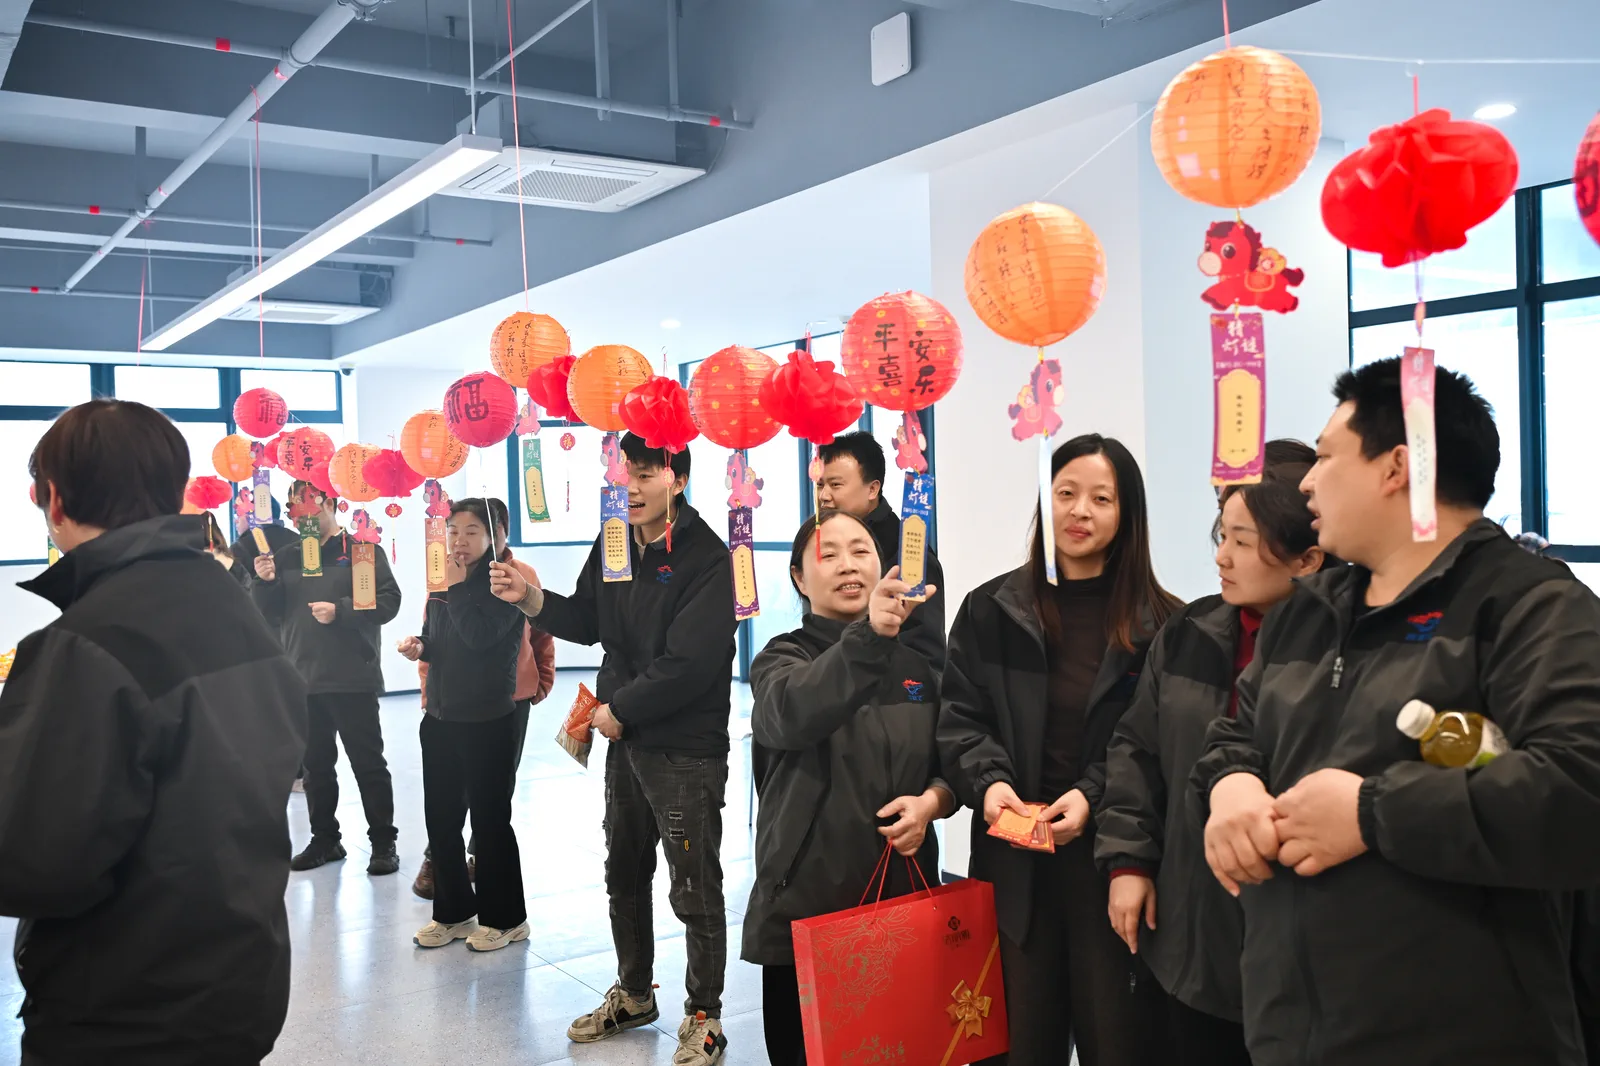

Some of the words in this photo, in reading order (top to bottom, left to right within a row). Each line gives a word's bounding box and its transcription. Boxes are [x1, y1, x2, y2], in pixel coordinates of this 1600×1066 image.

[873, 323, 933, 363] 平安
[878, 354, 937, 395] 喜乐
[446, 377, 490, 424] 福
[563, 435, 573, 448] 福
